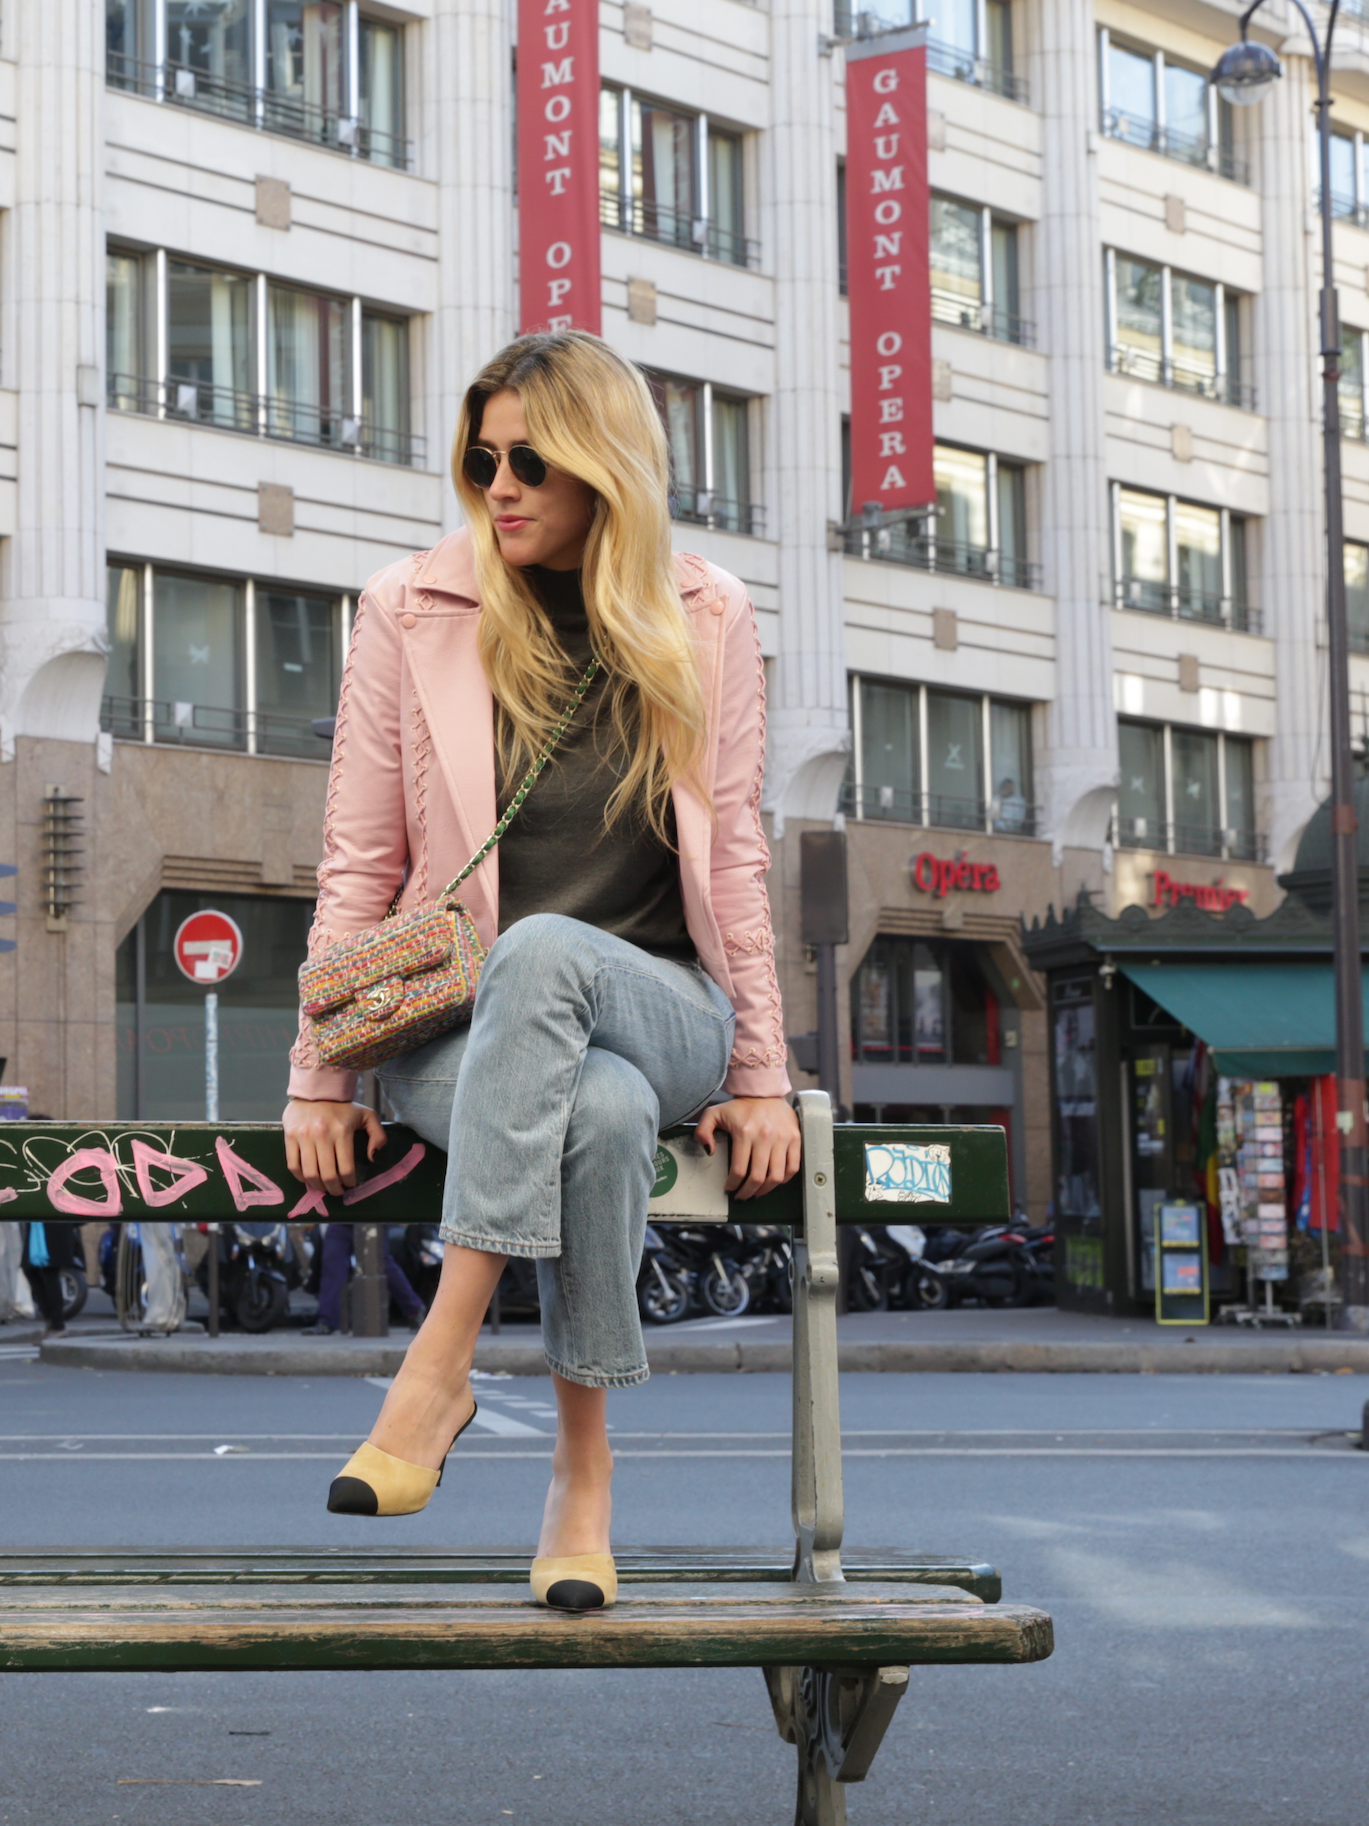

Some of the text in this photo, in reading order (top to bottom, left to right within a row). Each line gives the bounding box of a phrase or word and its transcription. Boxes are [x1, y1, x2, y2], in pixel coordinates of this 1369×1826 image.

[870, 69, 907, 491] GAUMONT OPERA
[915, 852, 1001, 897] Opéra
